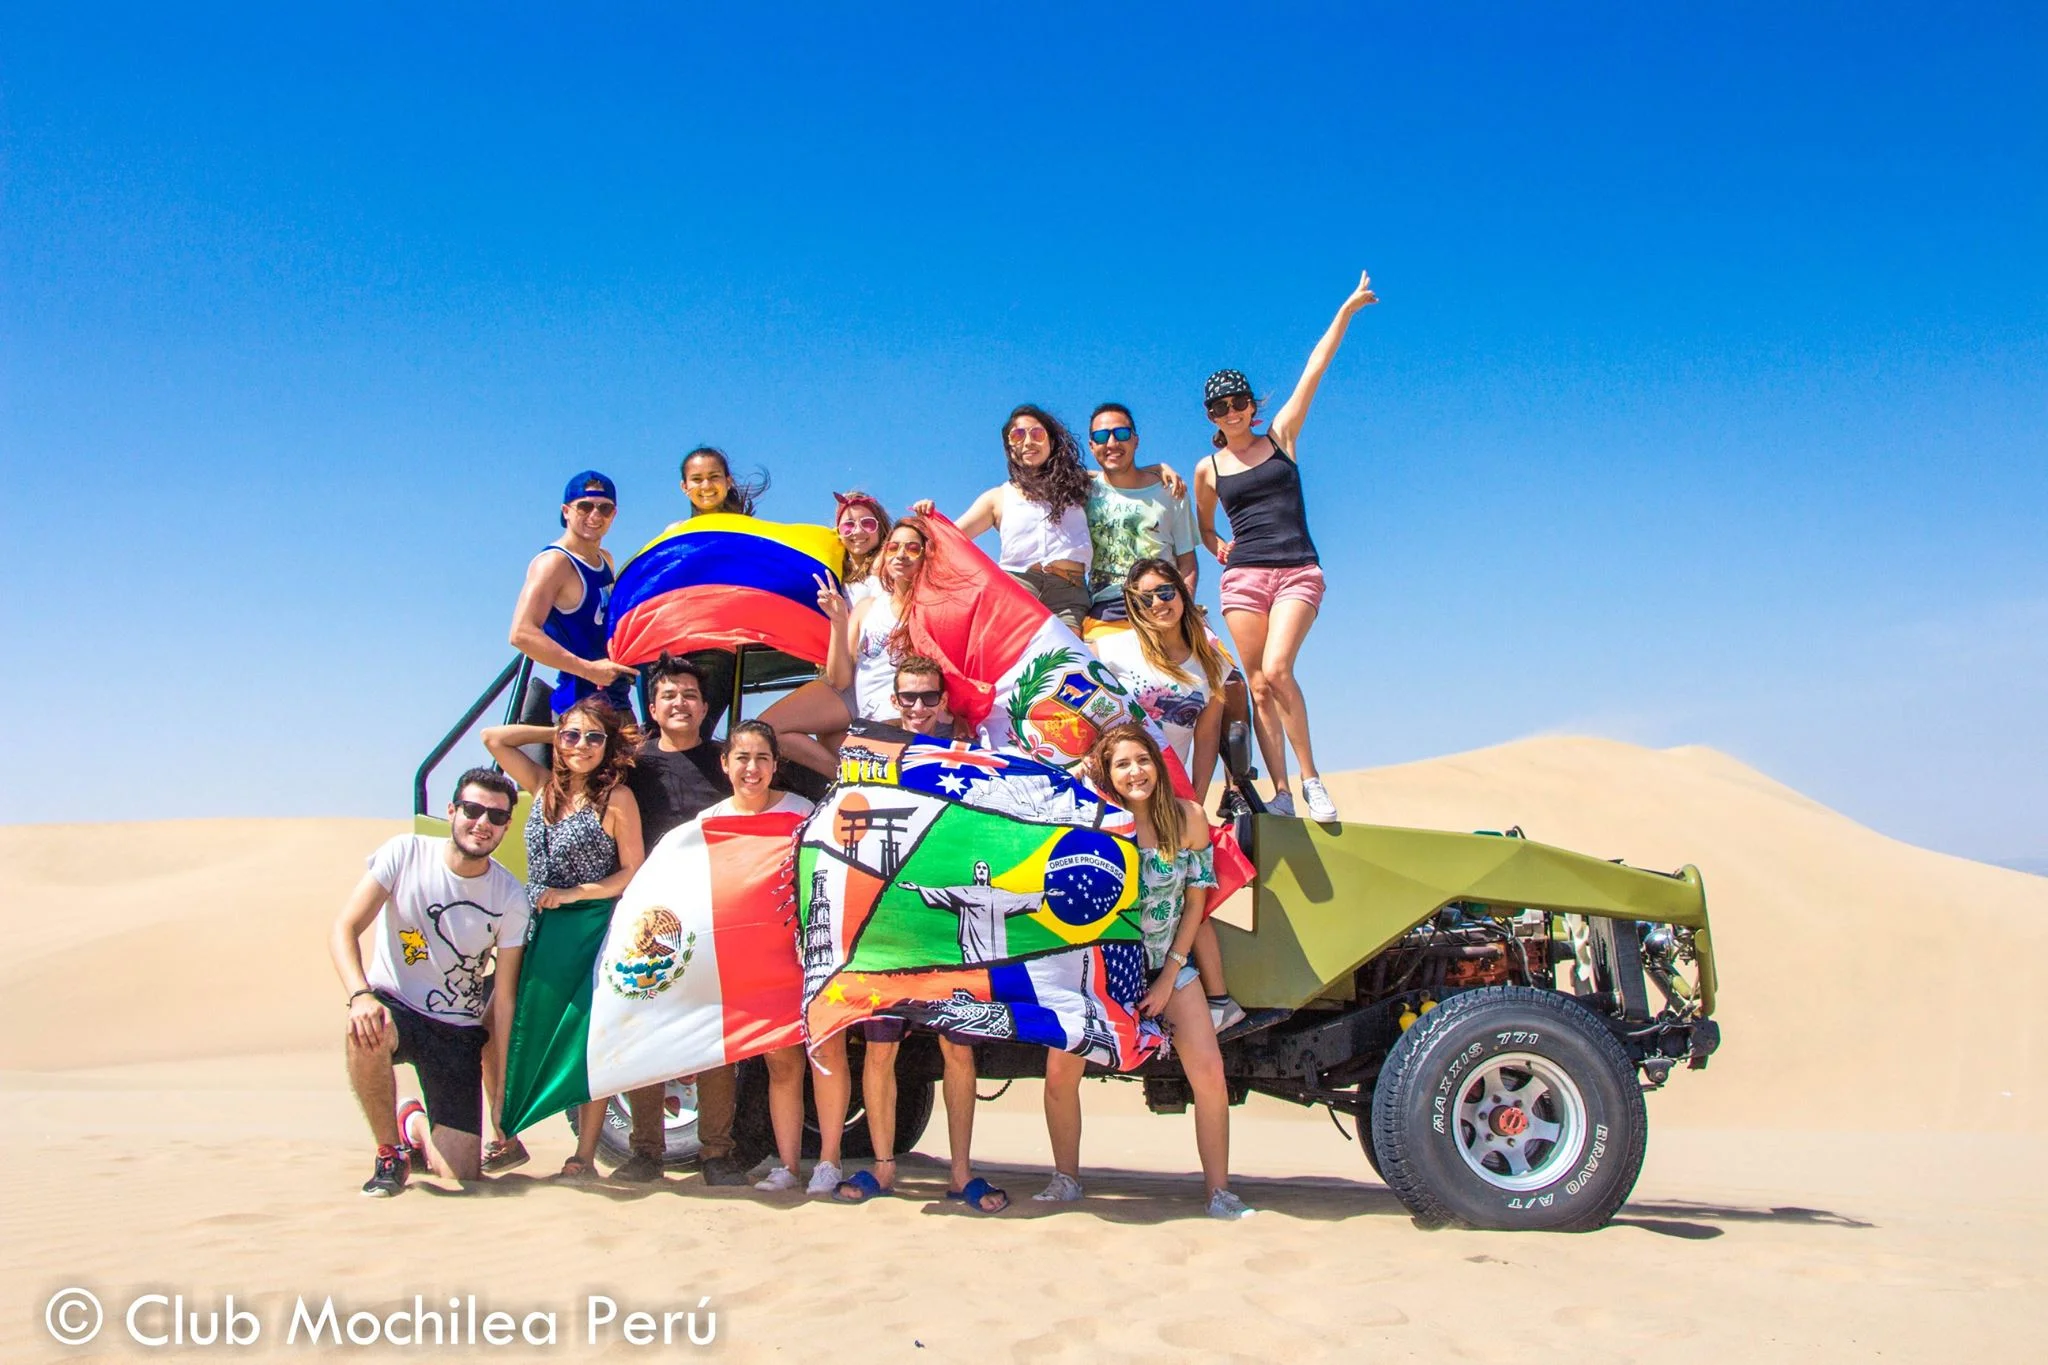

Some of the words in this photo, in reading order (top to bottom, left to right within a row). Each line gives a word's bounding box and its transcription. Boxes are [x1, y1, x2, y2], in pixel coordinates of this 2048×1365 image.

[1049, 857, 1074, 870] ORDEM
[1074, 856, 1080, 864] E
[1080, 856, 1124, 880] PROGRESSO
[1433, 1042, 1483, 1135] MAXXIS
[1497, 1031, 1539, 1045] 771
[1566, 1124, 1608, 1195] BRAVO
[1507, 1193, 1554, 1209] A/T
